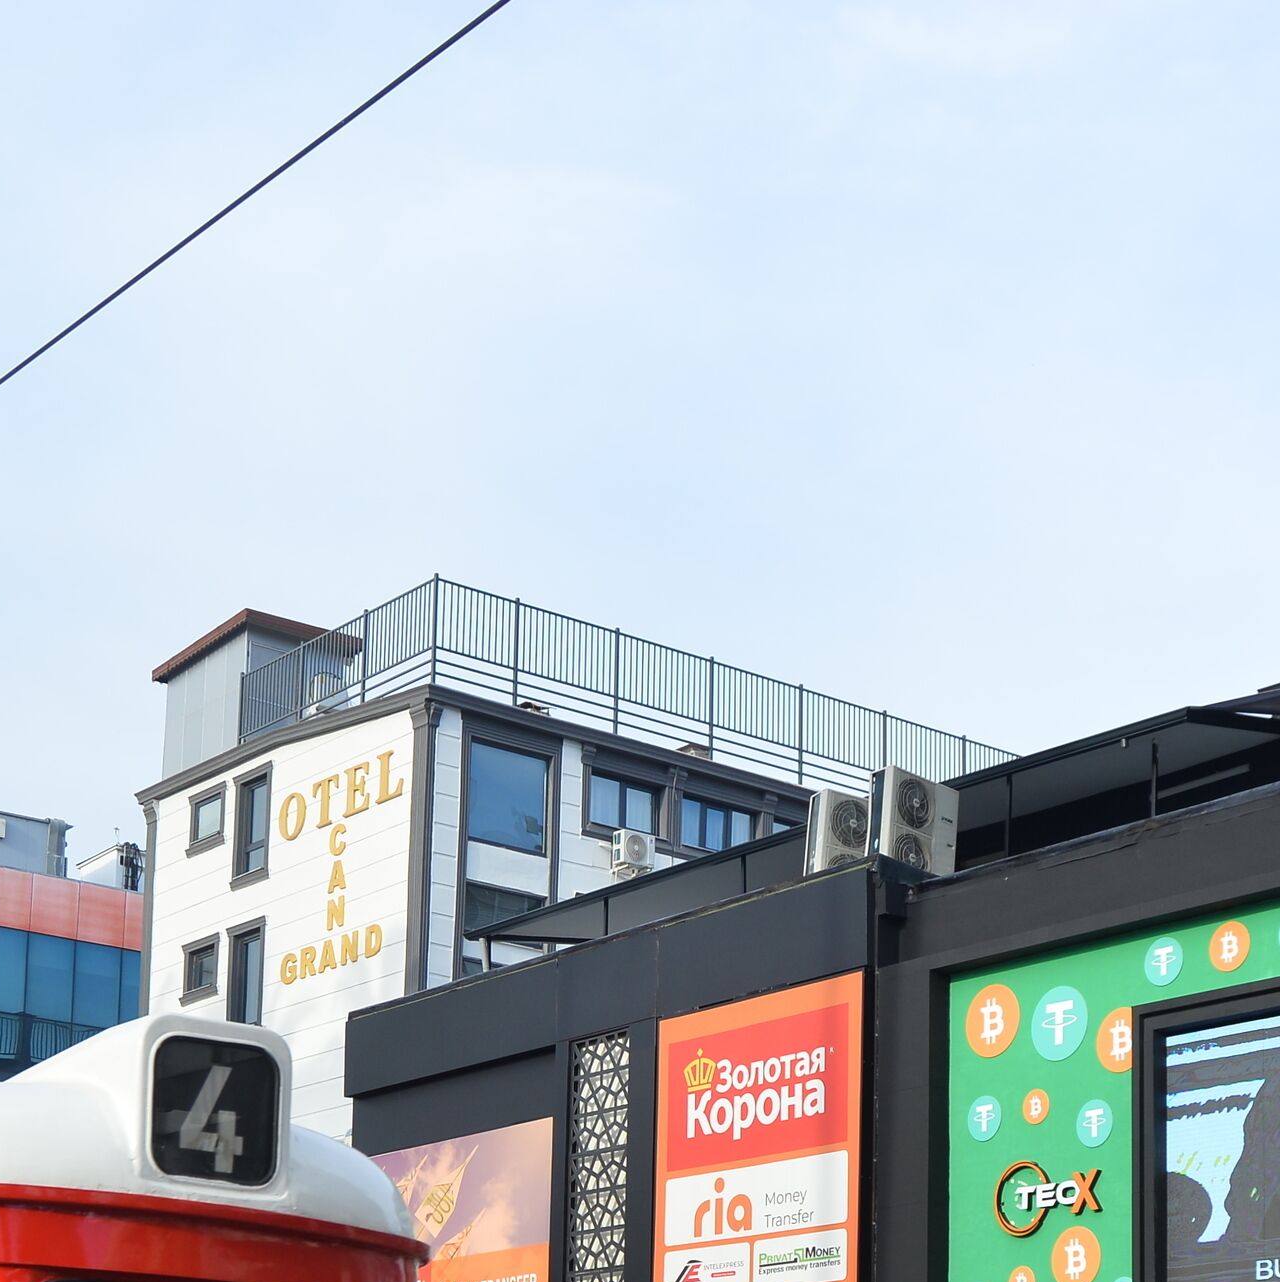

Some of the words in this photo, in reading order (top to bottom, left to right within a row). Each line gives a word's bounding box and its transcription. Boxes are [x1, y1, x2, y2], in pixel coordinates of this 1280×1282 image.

[279, 750, 404, 841] OTEL
[327, 823, 347, 930] CAN
[280, 924, 382, 985] GRAND
[716, 1047, 826, 1093] Золотая
[179, 1065, 244, 1173] 4
[686, 1079, 825, 1140] Корона
[694, 1177, 753, 1237] ria
[764, 1209, 814, 1228] Transfer
[765, 1190, 807, 1206] Money
[759, 1264, 784, 1276] Express
[786, 1263, 807, 1273] money
[810, 1259, 841, 1269] transfers
